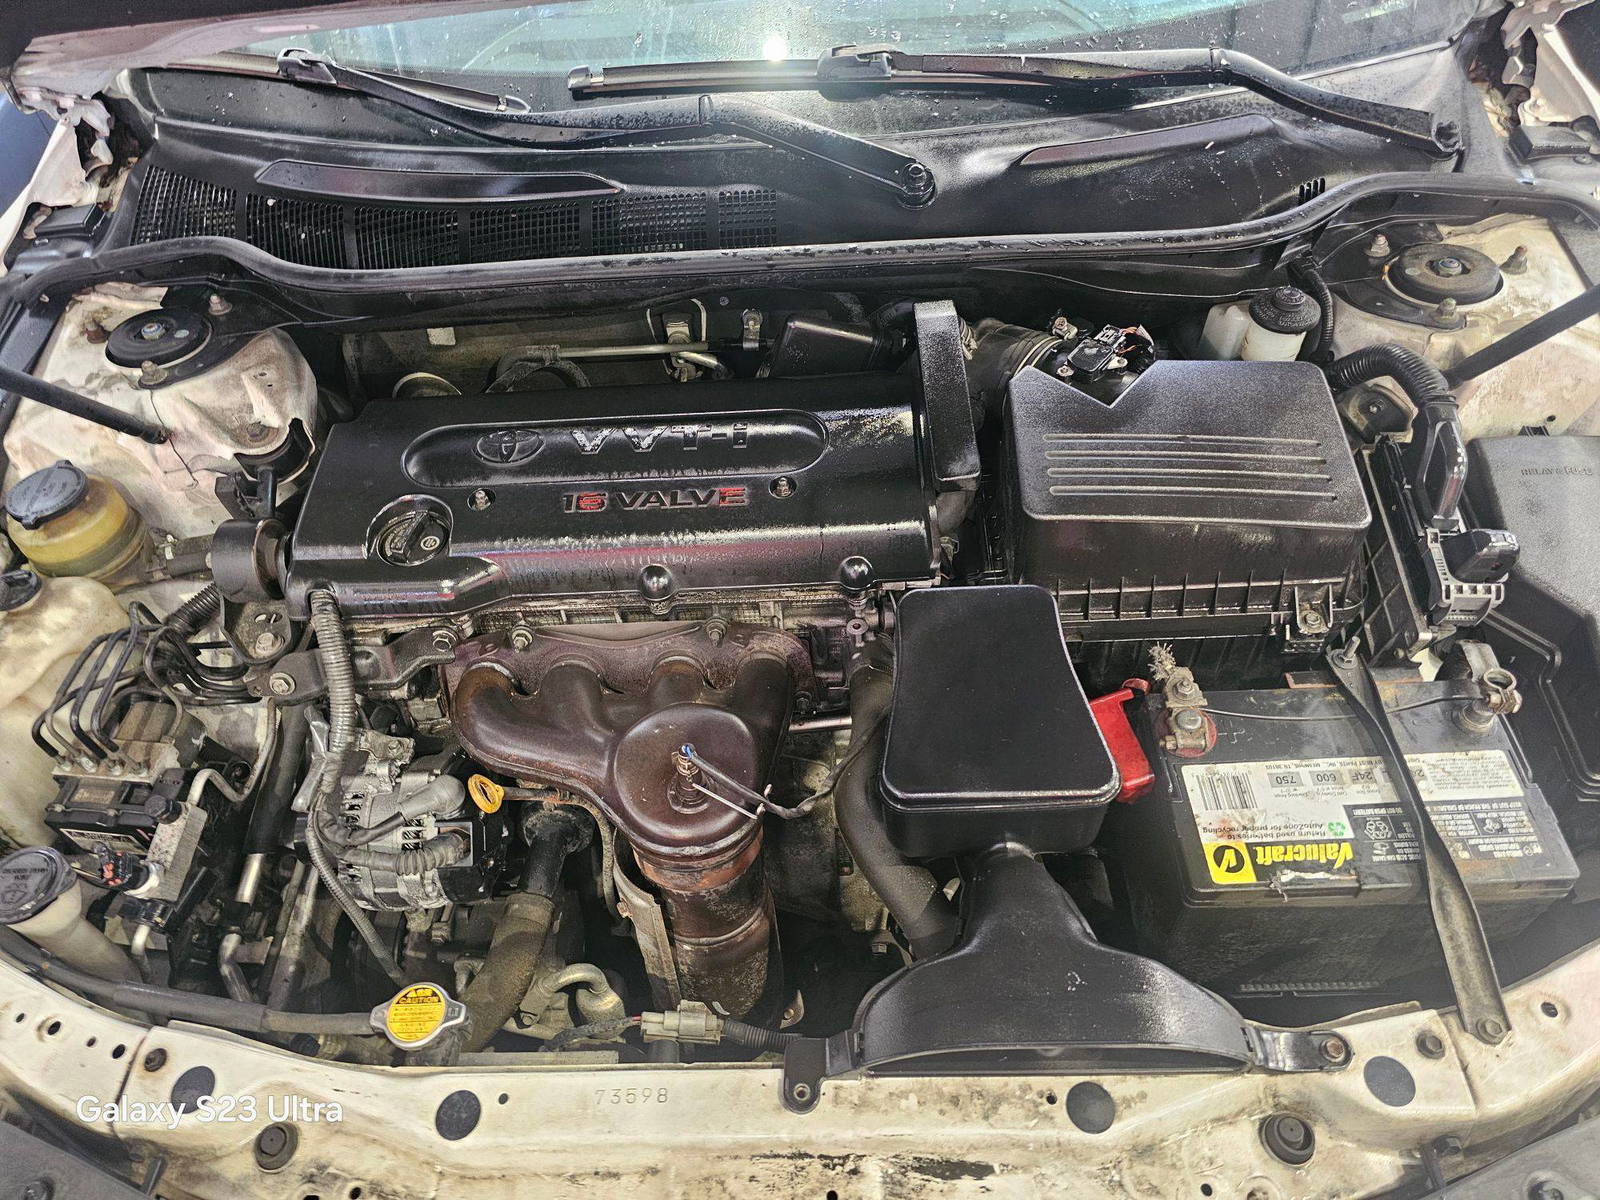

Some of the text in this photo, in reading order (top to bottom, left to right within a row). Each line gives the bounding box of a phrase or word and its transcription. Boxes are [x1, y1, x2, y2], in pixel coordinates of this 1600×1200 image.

[563, 486, 749, 514] 16 VALVE
[1276, 775, 1296, 784] 750
[1316, 773, 1336, 782] 600
[1352, 771, 1372, 780] 24F
[1202, 826, 1239, 834] recycling
[1255, 842, 1353, 869] Valucraft
[594, 1087, 668, 1105] 73598
